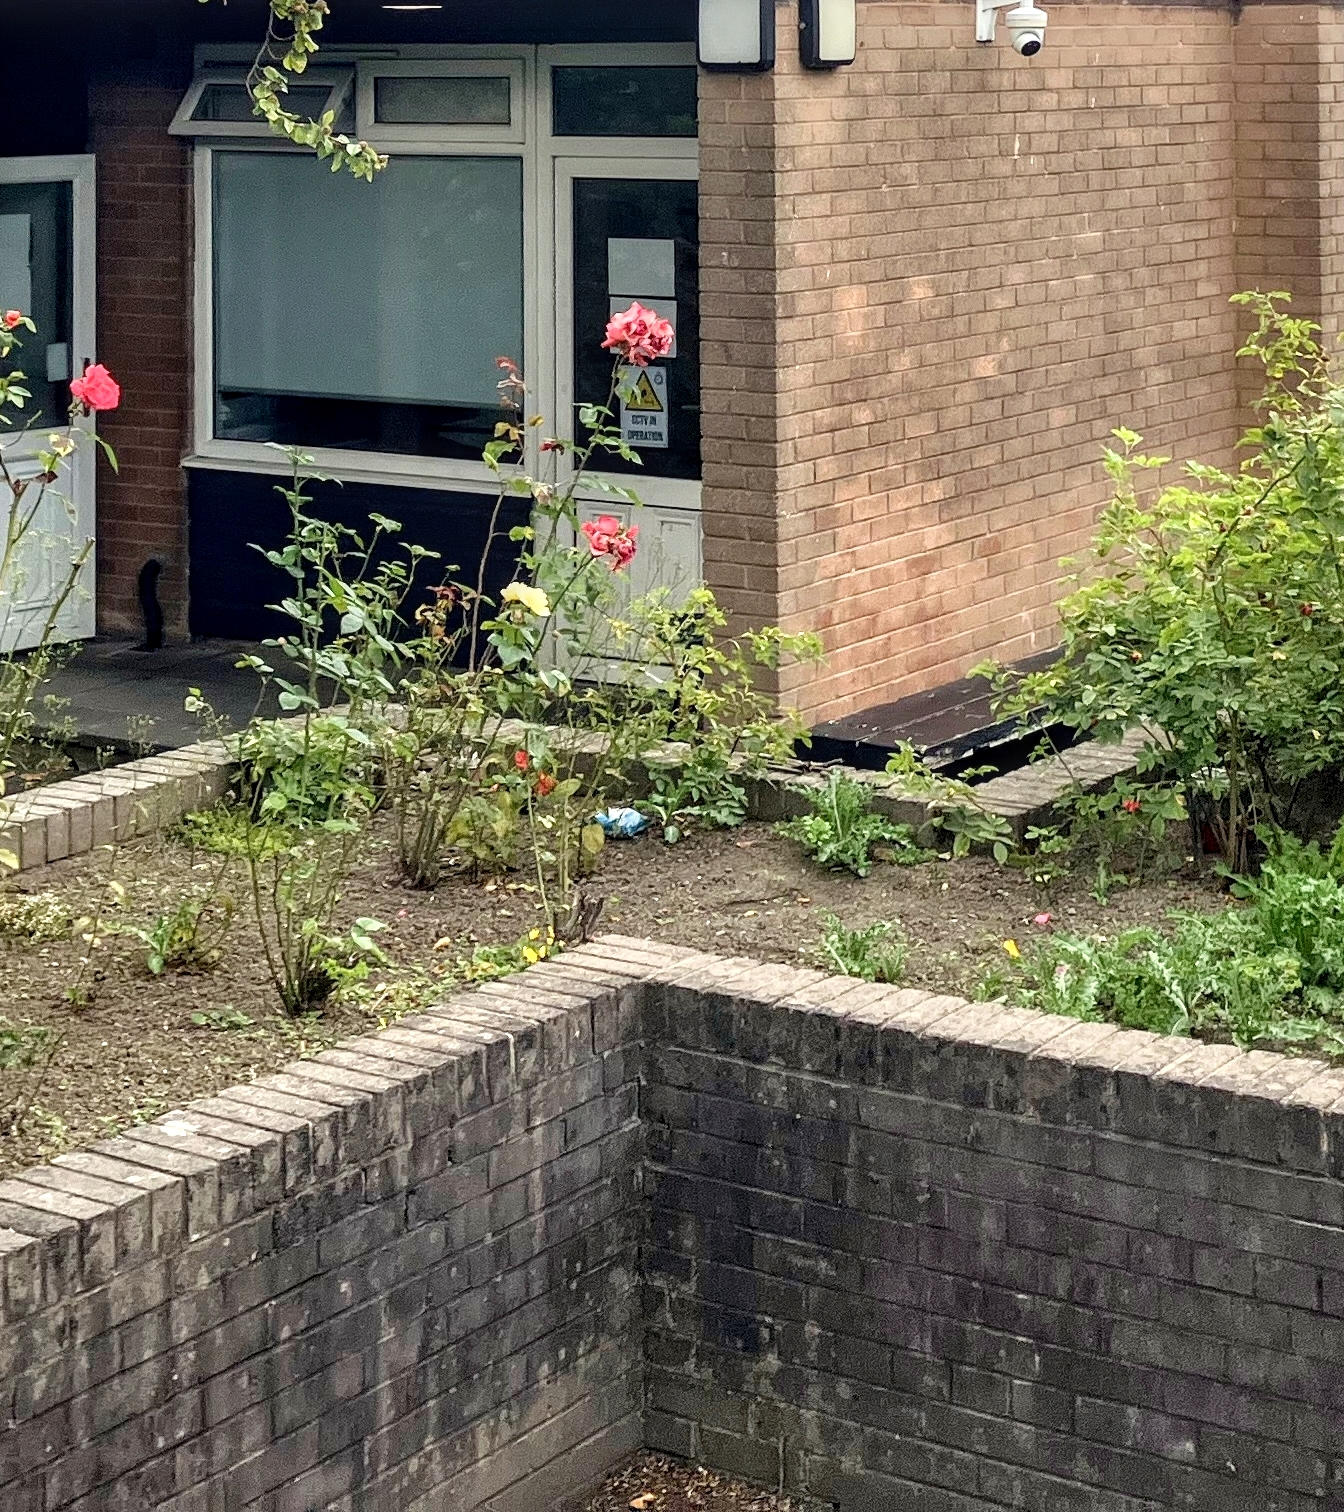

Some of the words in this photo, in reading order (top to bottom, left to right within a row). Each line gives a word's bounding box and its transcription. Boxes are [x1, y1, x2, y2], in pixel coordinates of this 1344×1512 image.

[631, 414, 648, 426] CCTV
[649, 415, 657, 426] IN
[627, 430, 664, 441] OPERATION
